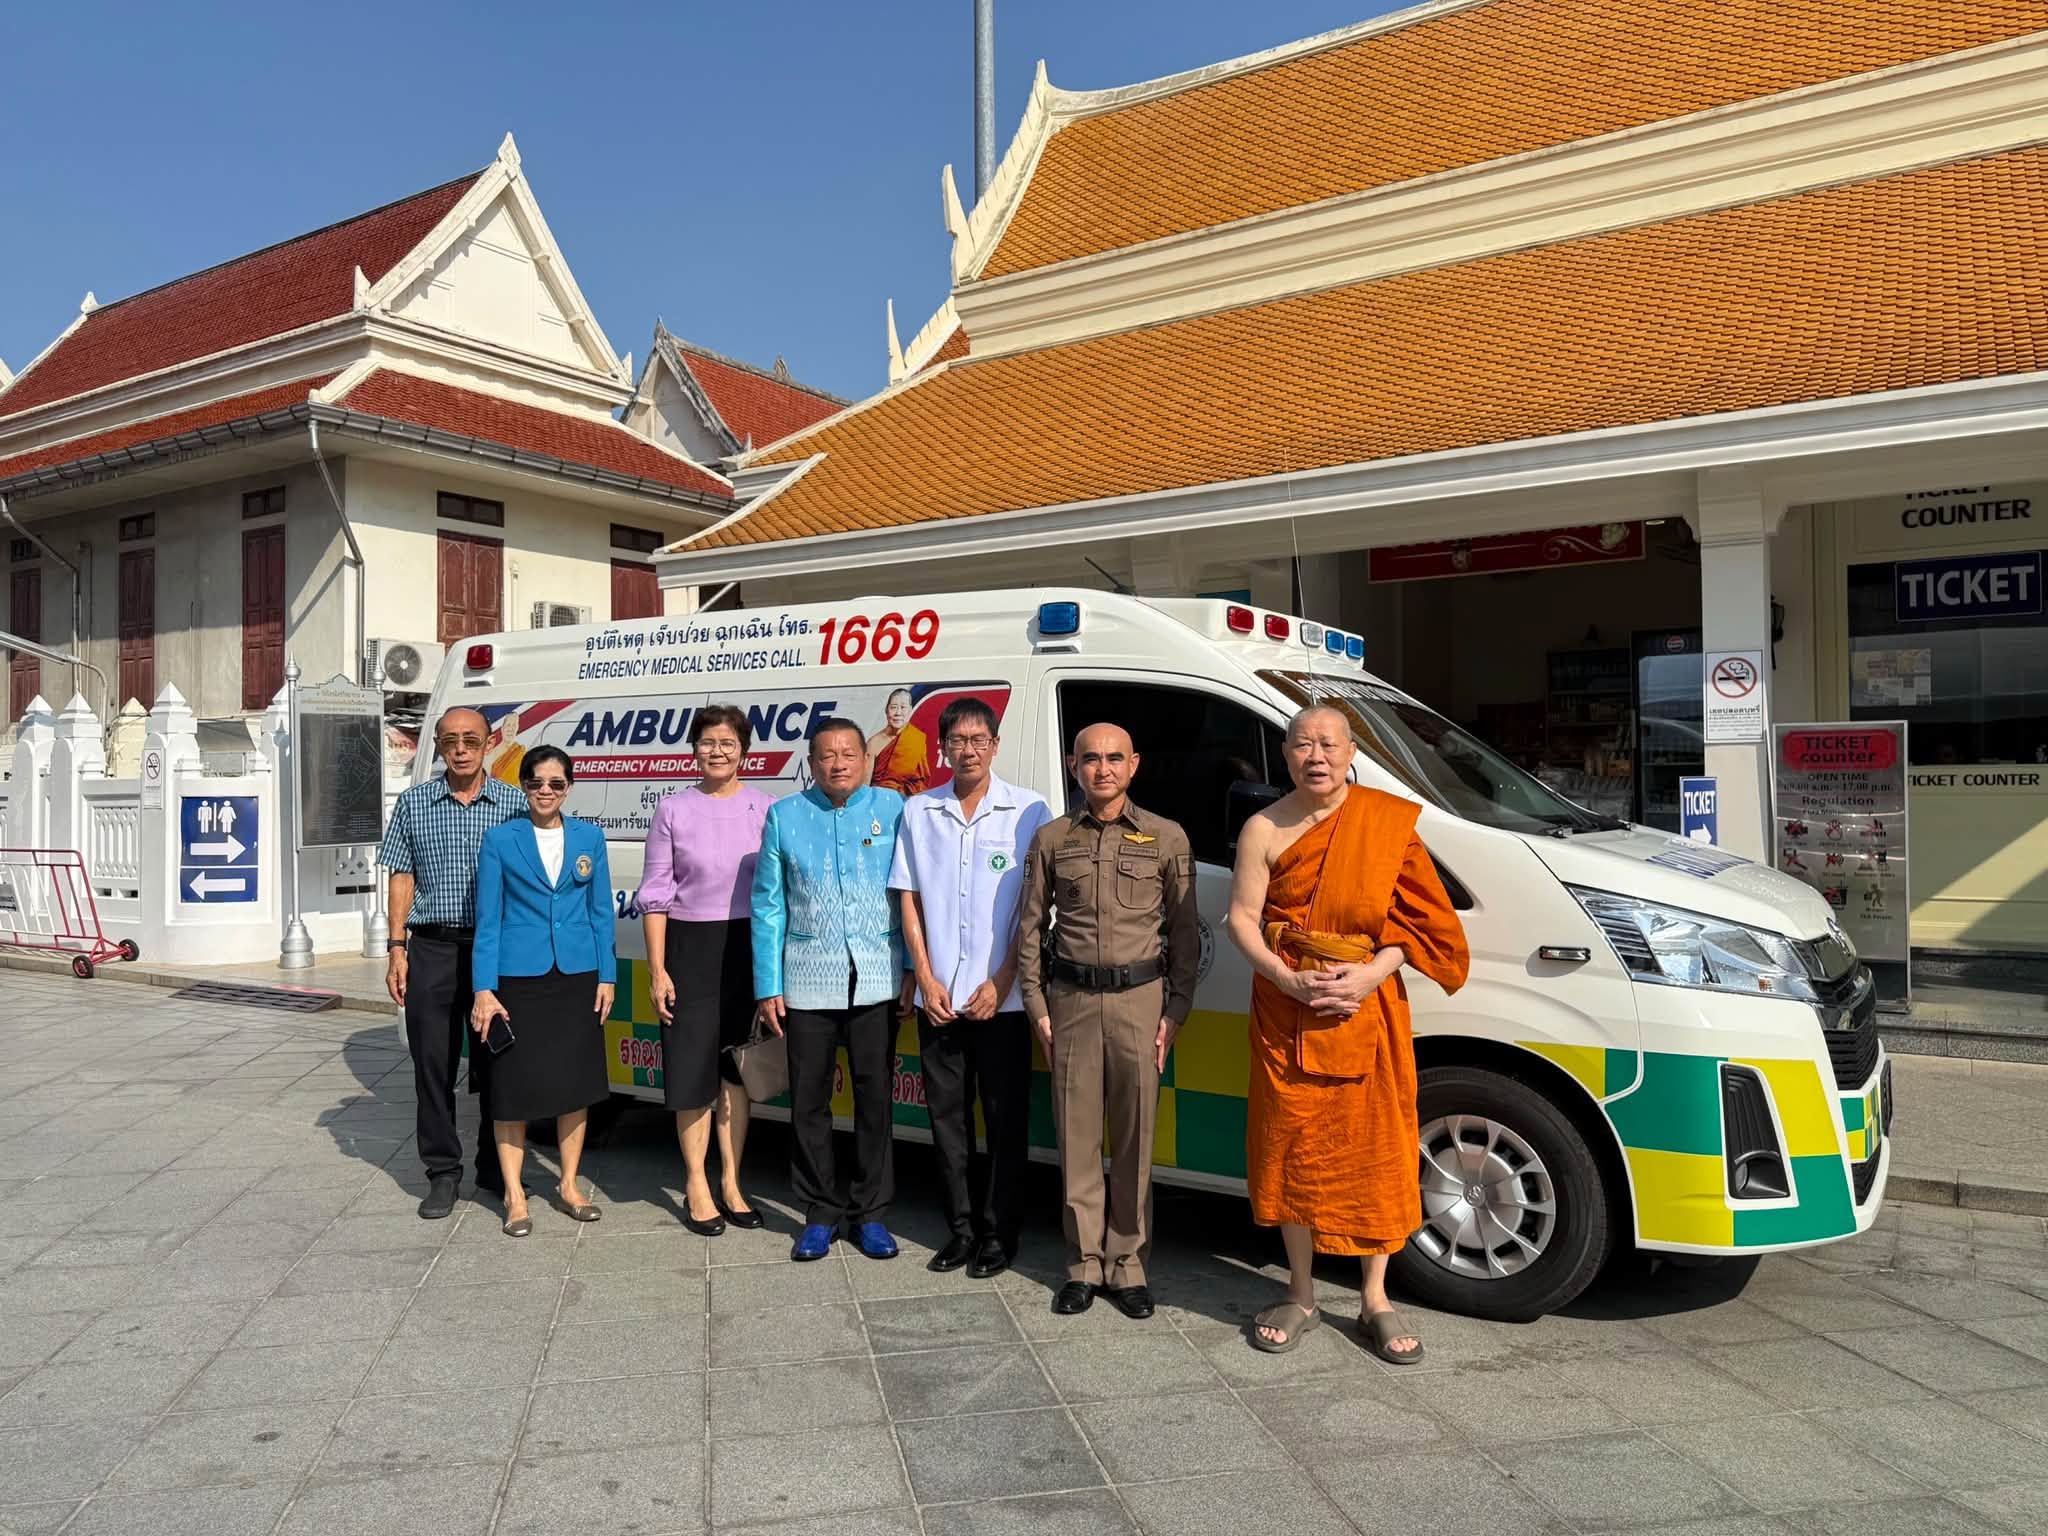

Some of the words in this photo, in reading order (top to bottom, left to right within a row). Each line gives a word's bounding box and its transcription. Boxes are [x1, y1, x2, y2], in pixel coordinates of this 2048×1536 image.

[1901, 499, 2031, 529] COUNTER
[1901, 565, 2035, 608] TICKET
[649, 620, 711, 646] เจ็บป่วย
[715, 617, 772, 649] ฉุกเฉิน
[819, 609, 940, 665] 1669
[578, 657, 649, 680] EMERGENCY
[650, 655, 703, 675] MEDICAL
[706, 650, 768, 672] SERVICES
[770, 648, 806, 668] CALL.
[566, 701, 838, 746] AMBUNCE
[1803, 735, 1872, 750] TICKET
[573, 759, 647, 773] EMERGENCY
[649, 757, 704, 772] MEDICA
[1800, 752, 1877, 765] counter
[1807, 773, 1840, 782] OPEN
[1841, 772, 1869, 782] TIME
[1963, 773, 2040, 786] COUNTER
[1684, 791, 1716, 816] TICKET
[1802, 795, 1875, 807] Regulation
